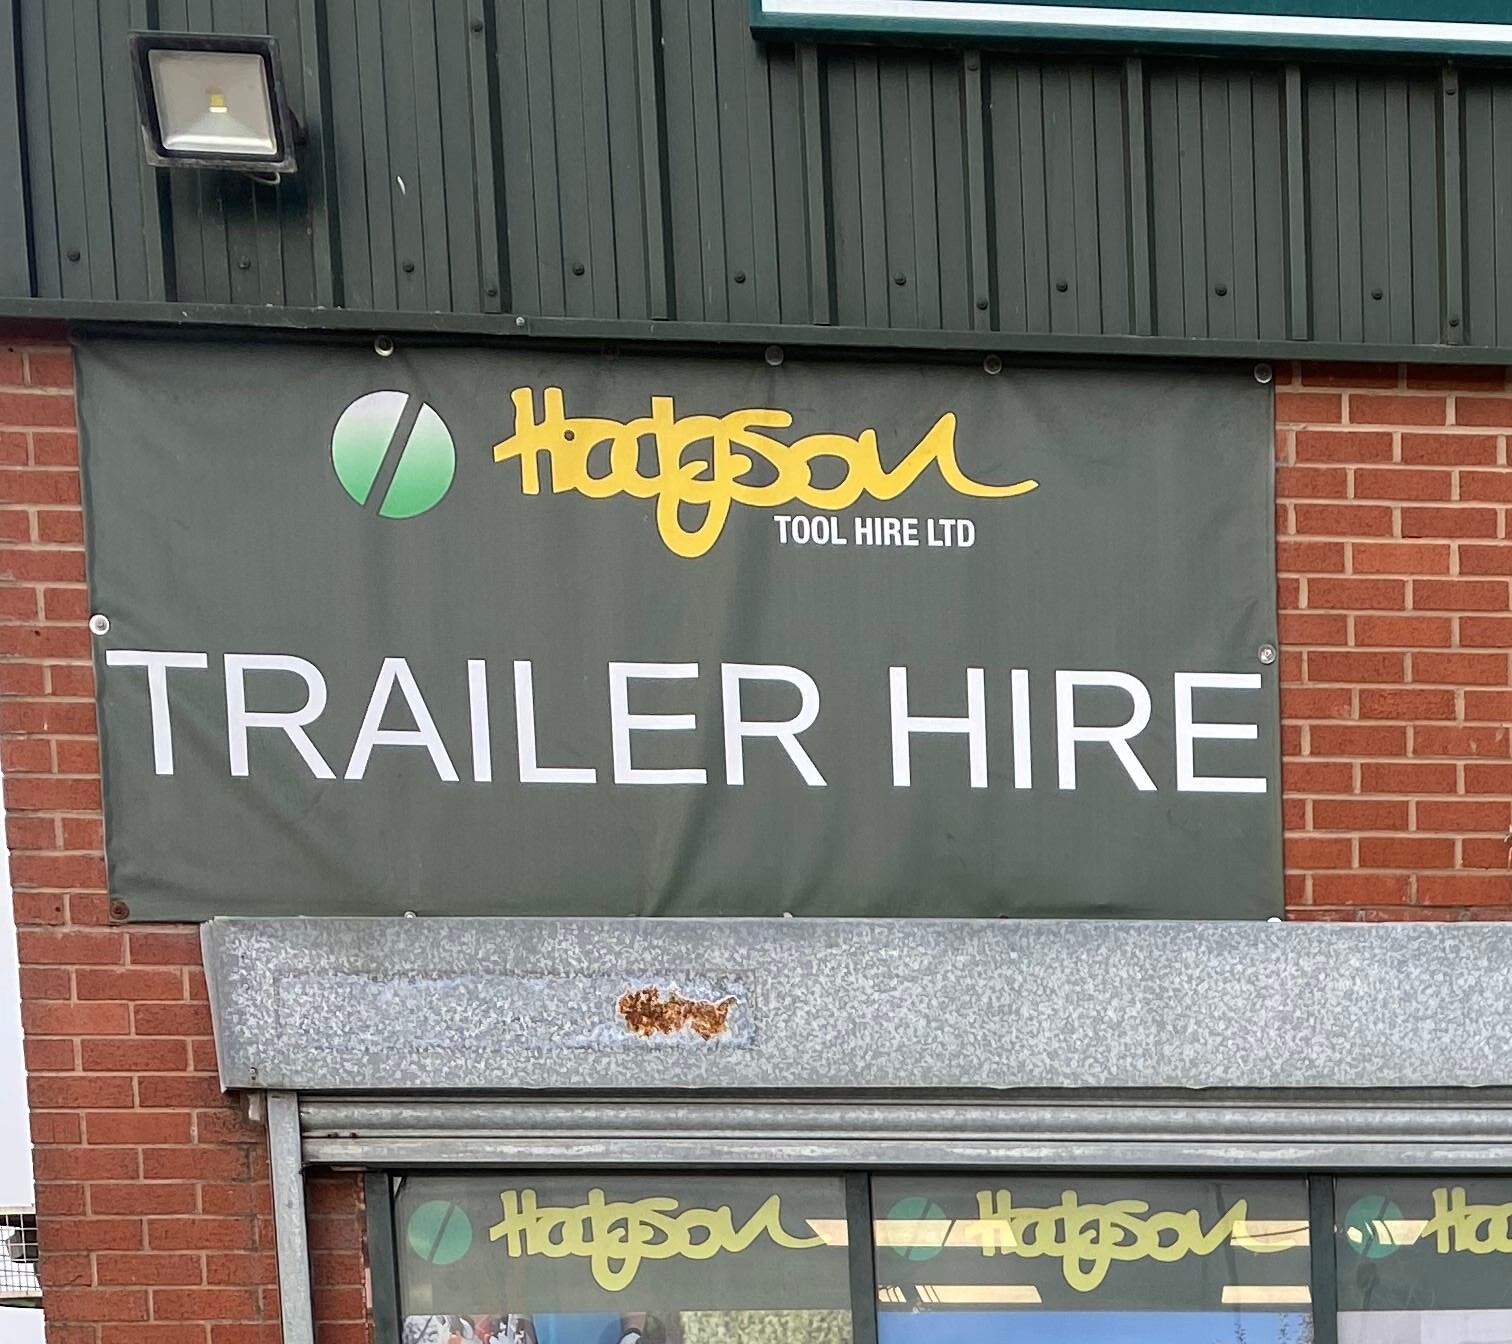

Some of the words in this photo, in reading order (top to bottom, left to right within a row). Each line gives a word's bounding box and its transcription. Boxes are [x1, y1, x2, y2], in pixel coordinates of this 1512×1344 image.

[493, 386, 1038, 558] Hodgson
[774, 514, 844, 546] TOOL
[854, 516, 920, 548] HIRE
[926, 518, 977, 549] LTD
[106, 650, 828, 787] TRAILER
[888, 665, 1269, 793] HIRE
[489, 1186, 832, 1293] Hodgson
[965, 1188, 1297, 1293] Hodgson
